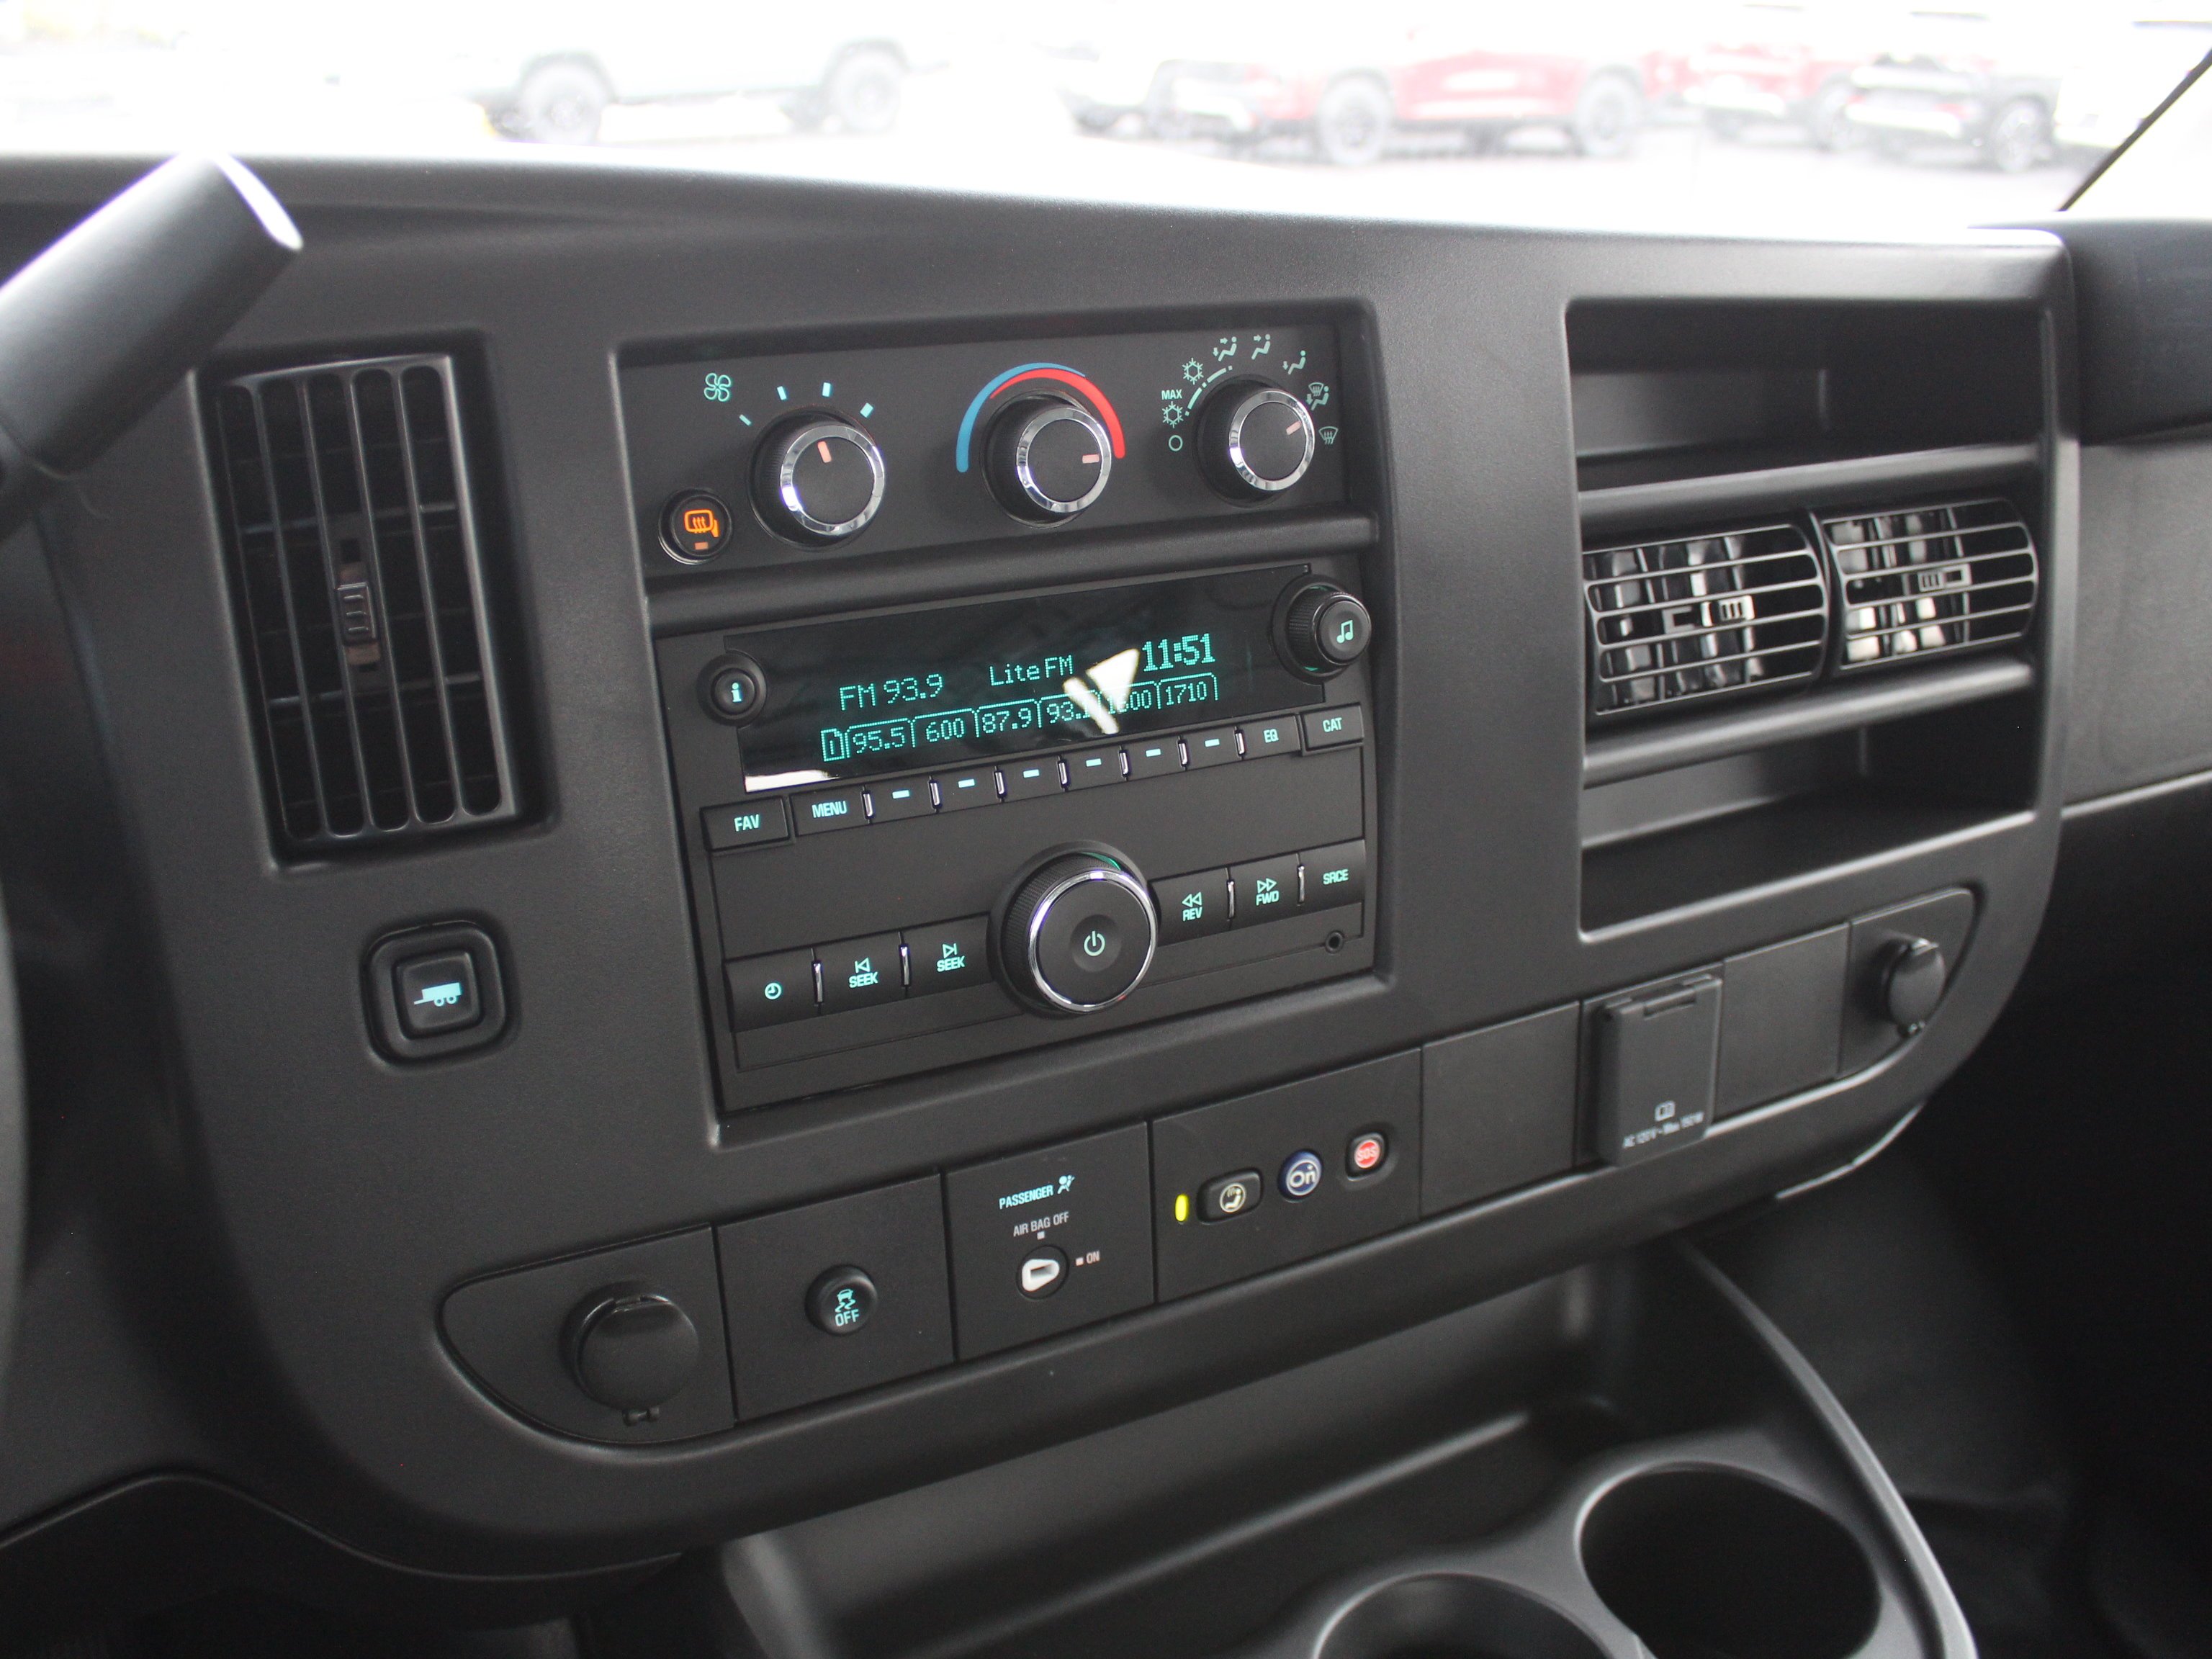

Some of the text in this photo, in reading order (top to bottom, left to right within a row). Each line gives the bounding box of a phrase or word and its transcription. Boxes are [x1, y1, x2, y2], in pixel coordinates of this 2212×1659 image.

[1161, 390, 1182, 400] MAX
[1142, 633, 1216, 673] 11:51
[840, 673, 943, 711] FM 93.9
[852, 727, 906, 754] 95.5
[925, 718, 965, 742] 600
[981, 708, 1033, 734] 87.9
[1165, 681, 1208, 706] 1710
[1322, 717, 1343, 733] CAT
[1264, 728, 1280, 744] EQ
[811, 800, 848, 819] MENU
[734, 814, 760, 832] FAV
[1323, 869, 1349, 885] SRCE
[1256, 890, 1280, 906] FWD
[1182, 907, 1203, 922] REV
[936, 956, 966, 973] SEEK
[848, 971, 878, 989] SEEK
[999, 1184, 1054, 1210] PASSENGER
[1013, 1211, 1070, 1238] AIR BAG OFF
[1086, 1251, 1101, 1264] ON
[835, 1308, 860, 1327] OFF
